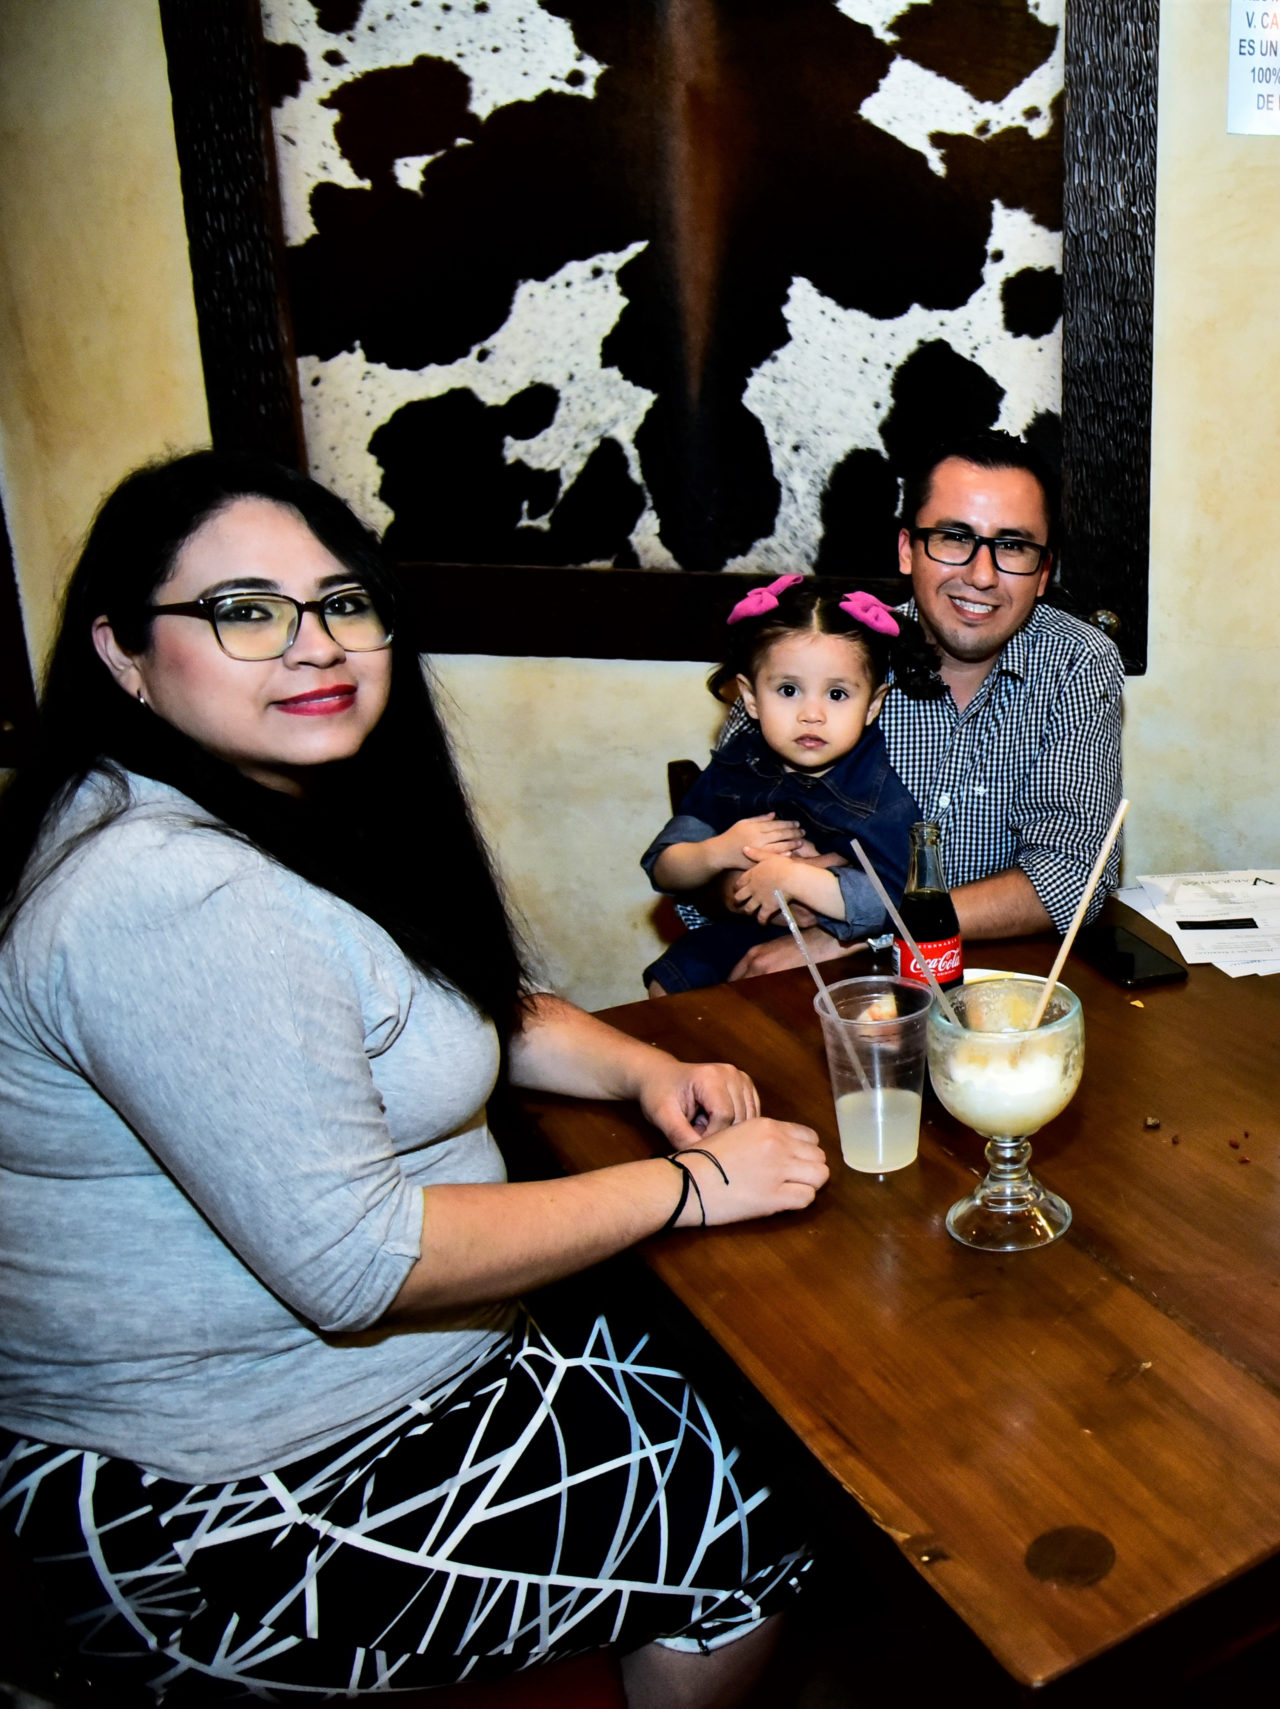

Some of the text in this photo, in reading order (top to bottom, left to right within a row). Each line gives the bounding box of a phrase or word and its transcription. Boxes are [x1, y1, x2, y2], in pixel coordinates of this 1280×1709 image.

[1246, 11, 1257, 29] V.
[1238, 39, 1256, 56] ES
[1260, 40, 1278, 57] UN
[1256, 93, 1274, 111] DE
